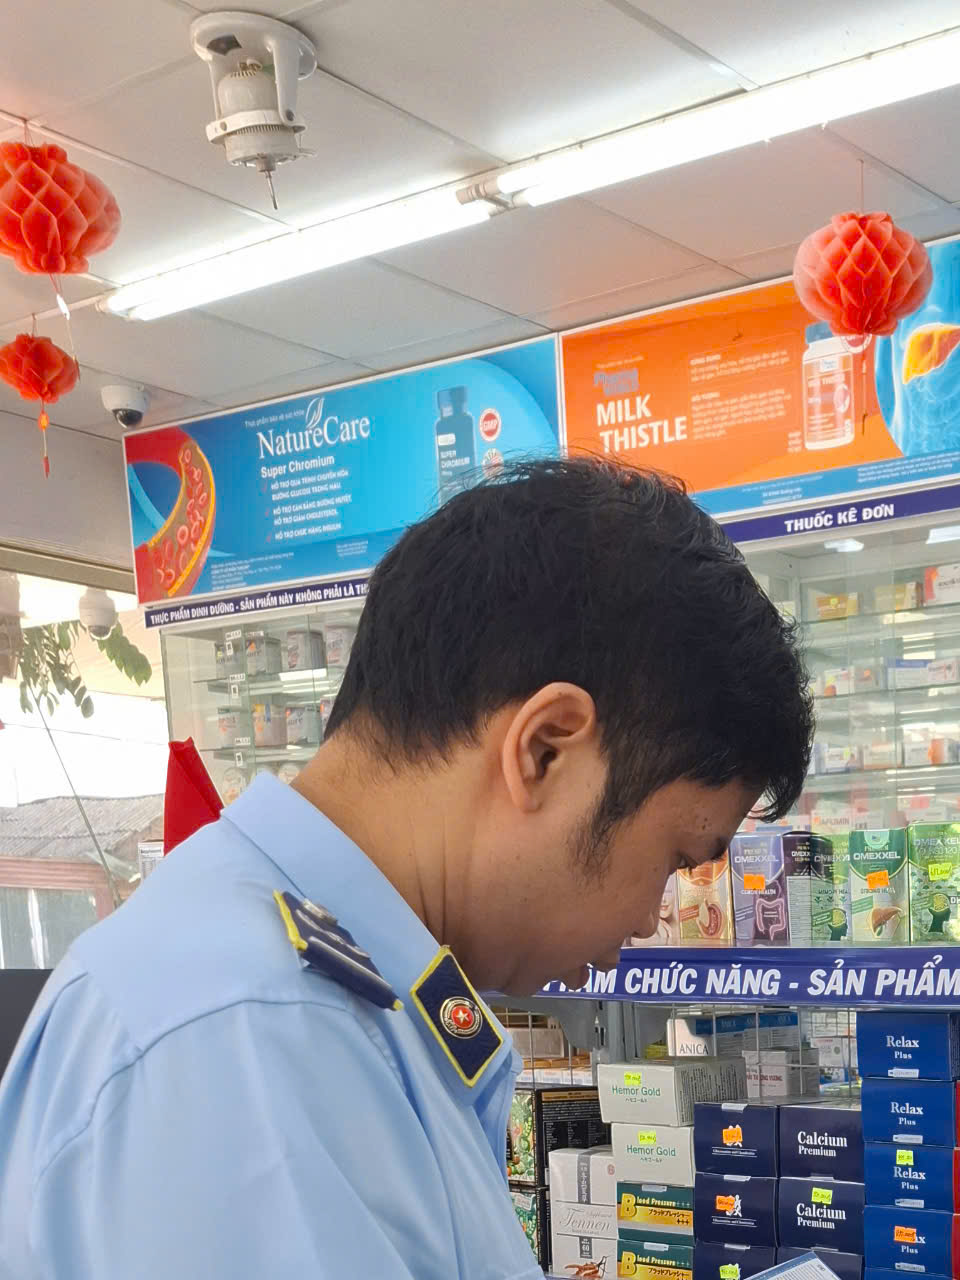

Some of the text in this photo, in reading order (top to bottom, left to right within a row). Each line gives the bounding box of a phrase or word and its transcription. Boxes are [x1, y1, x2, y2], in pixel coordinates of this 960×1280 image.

[596, 394, 651, 426] MILK
[256, 416, 370, 460] NatureCare
[600, 416, 687, 453] THISTLE
[261, 456, 335, 479] Super Chromium
[784, 503, 895, 533] THUỐC KÊ ĐƠN
[295, 588, 322, 602] KHÔNG
[344, 582, 354, 596] LÀ
[624, 962, 698, 995] CHỨC
[705, 962, 780, 995] NĂNG
[808, 959, 868, 996] SẢN
[885, 1035, 919, 1049] Relax
[894, 1051, 912, 1059] Plus
[612, 1086, 661, 1097] Hemor Gold
[890, 1102, 924, 1116] Relax
[898, 1117, 916, 1126] Plus
[798, 1131, 848, 1147] Calcium
[627, 1145, 676, 1157] Hemor Gold
[798, 1146, 836, 1157] Premium
[893, 1166, 926, 1181] Relax
[796, 1203, 846, 1220] Calcium
[797, 1217, 835, 1229] Premium
